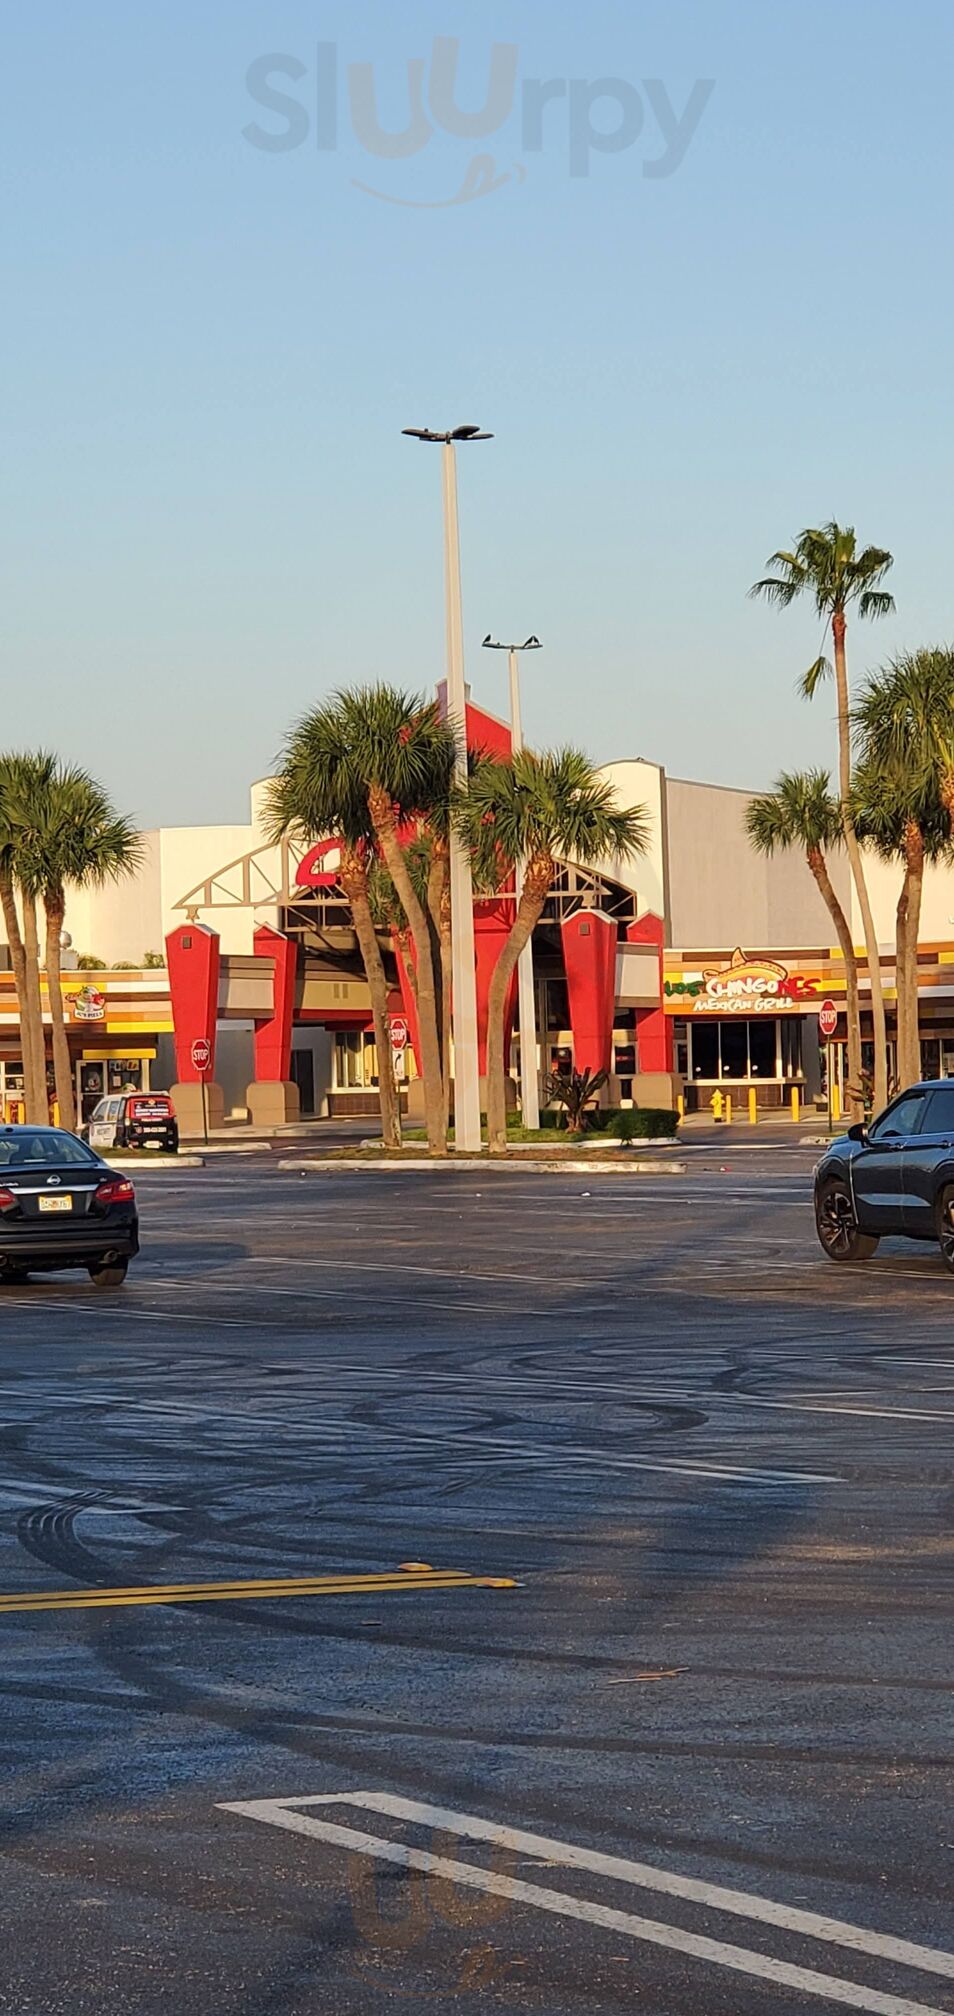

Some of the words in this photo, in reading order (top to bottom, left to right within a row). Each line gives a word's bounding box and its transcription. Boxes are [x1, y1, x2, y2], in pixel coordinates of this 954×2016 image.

[664, 980, 705, 997] LOS
[705, 976, 822, 998] CHINGONES
[693, 999, 751, 1012] MEXICAN
[754, 997, 794, 1012] GRILL
[820, 1010, 836, 1024] STOP
[391, 1029, 406, 1041] STOP
[193, 1049, 209, 1060] STOP
